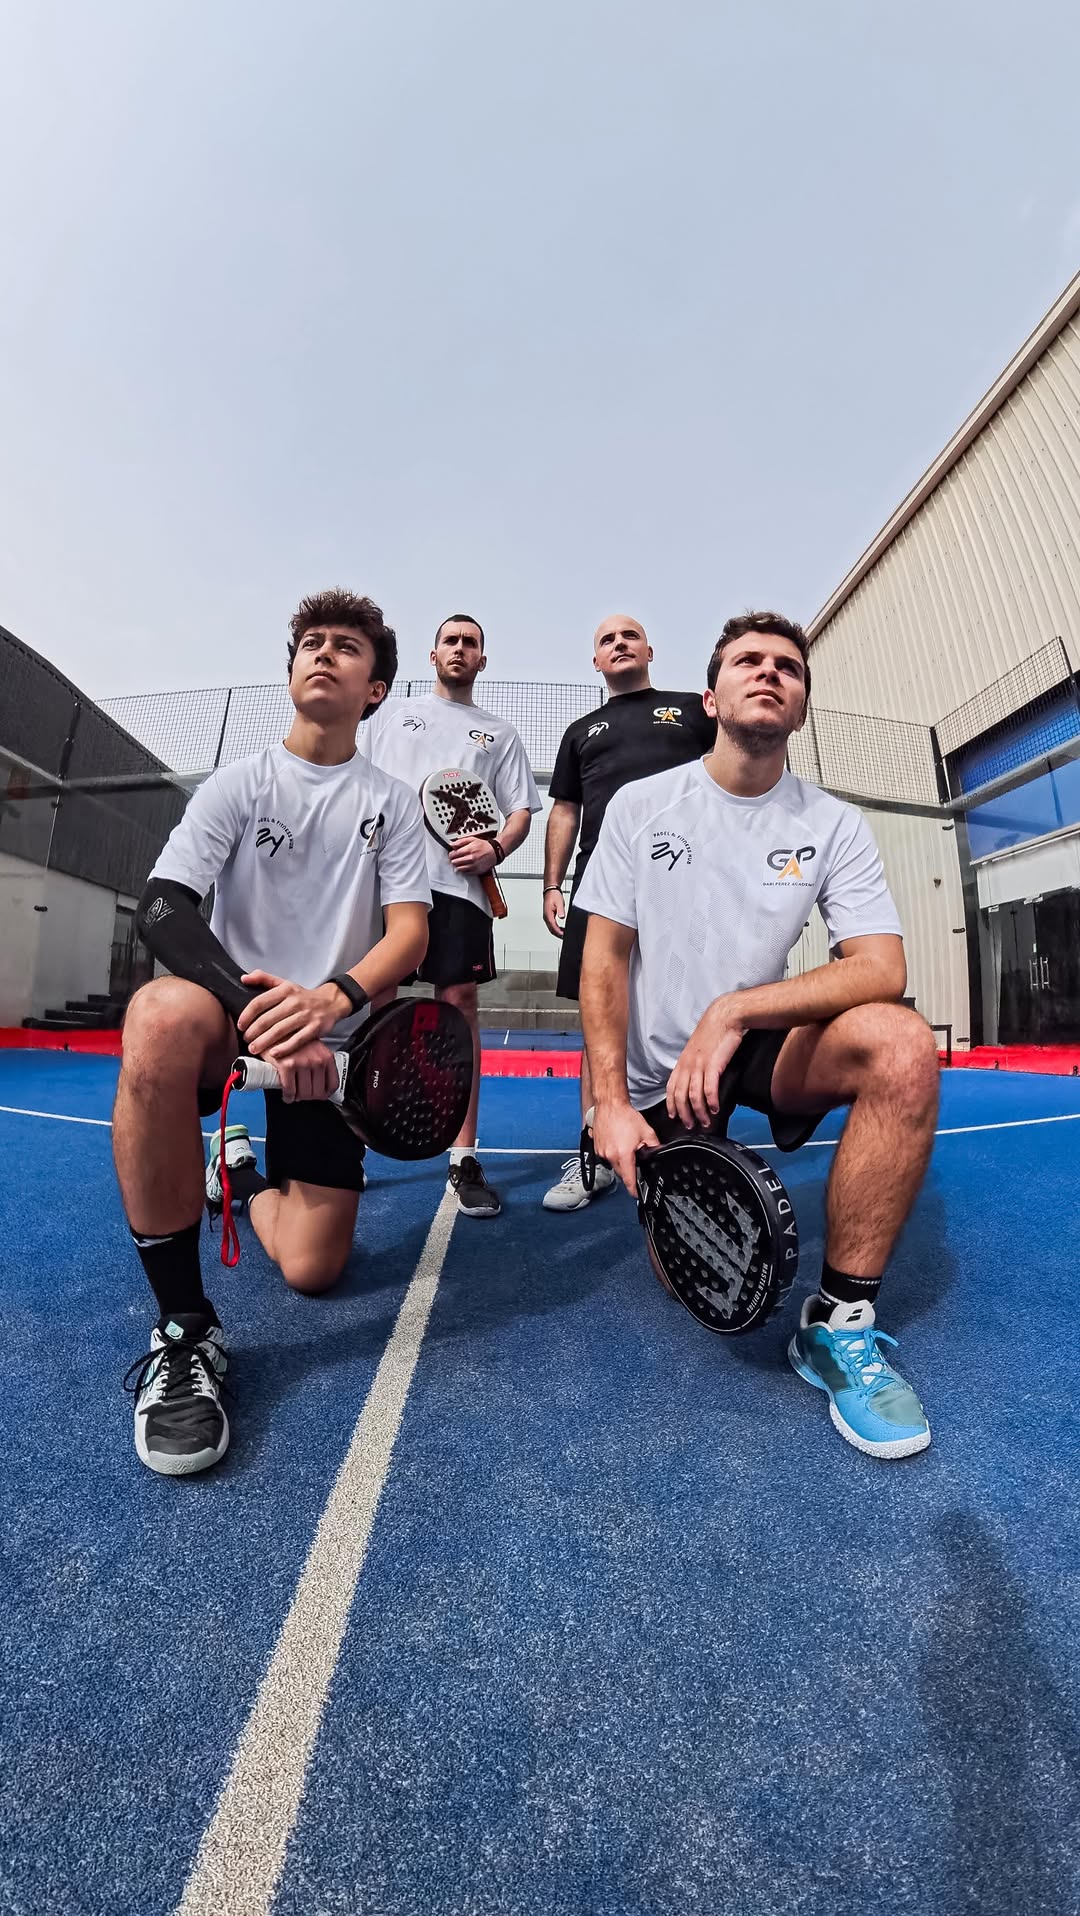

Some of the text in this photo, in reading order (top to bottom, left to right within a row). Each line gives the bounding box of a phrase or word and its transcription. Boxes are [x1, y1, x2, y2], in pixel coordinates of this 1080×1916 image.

[677, 835, 692, 853] FITNESS
[372, 1070, 380, 1089] PRO
[758, 1159, 799, 1261] PADEL
[758, 1262, 769, 1292] MASTER
